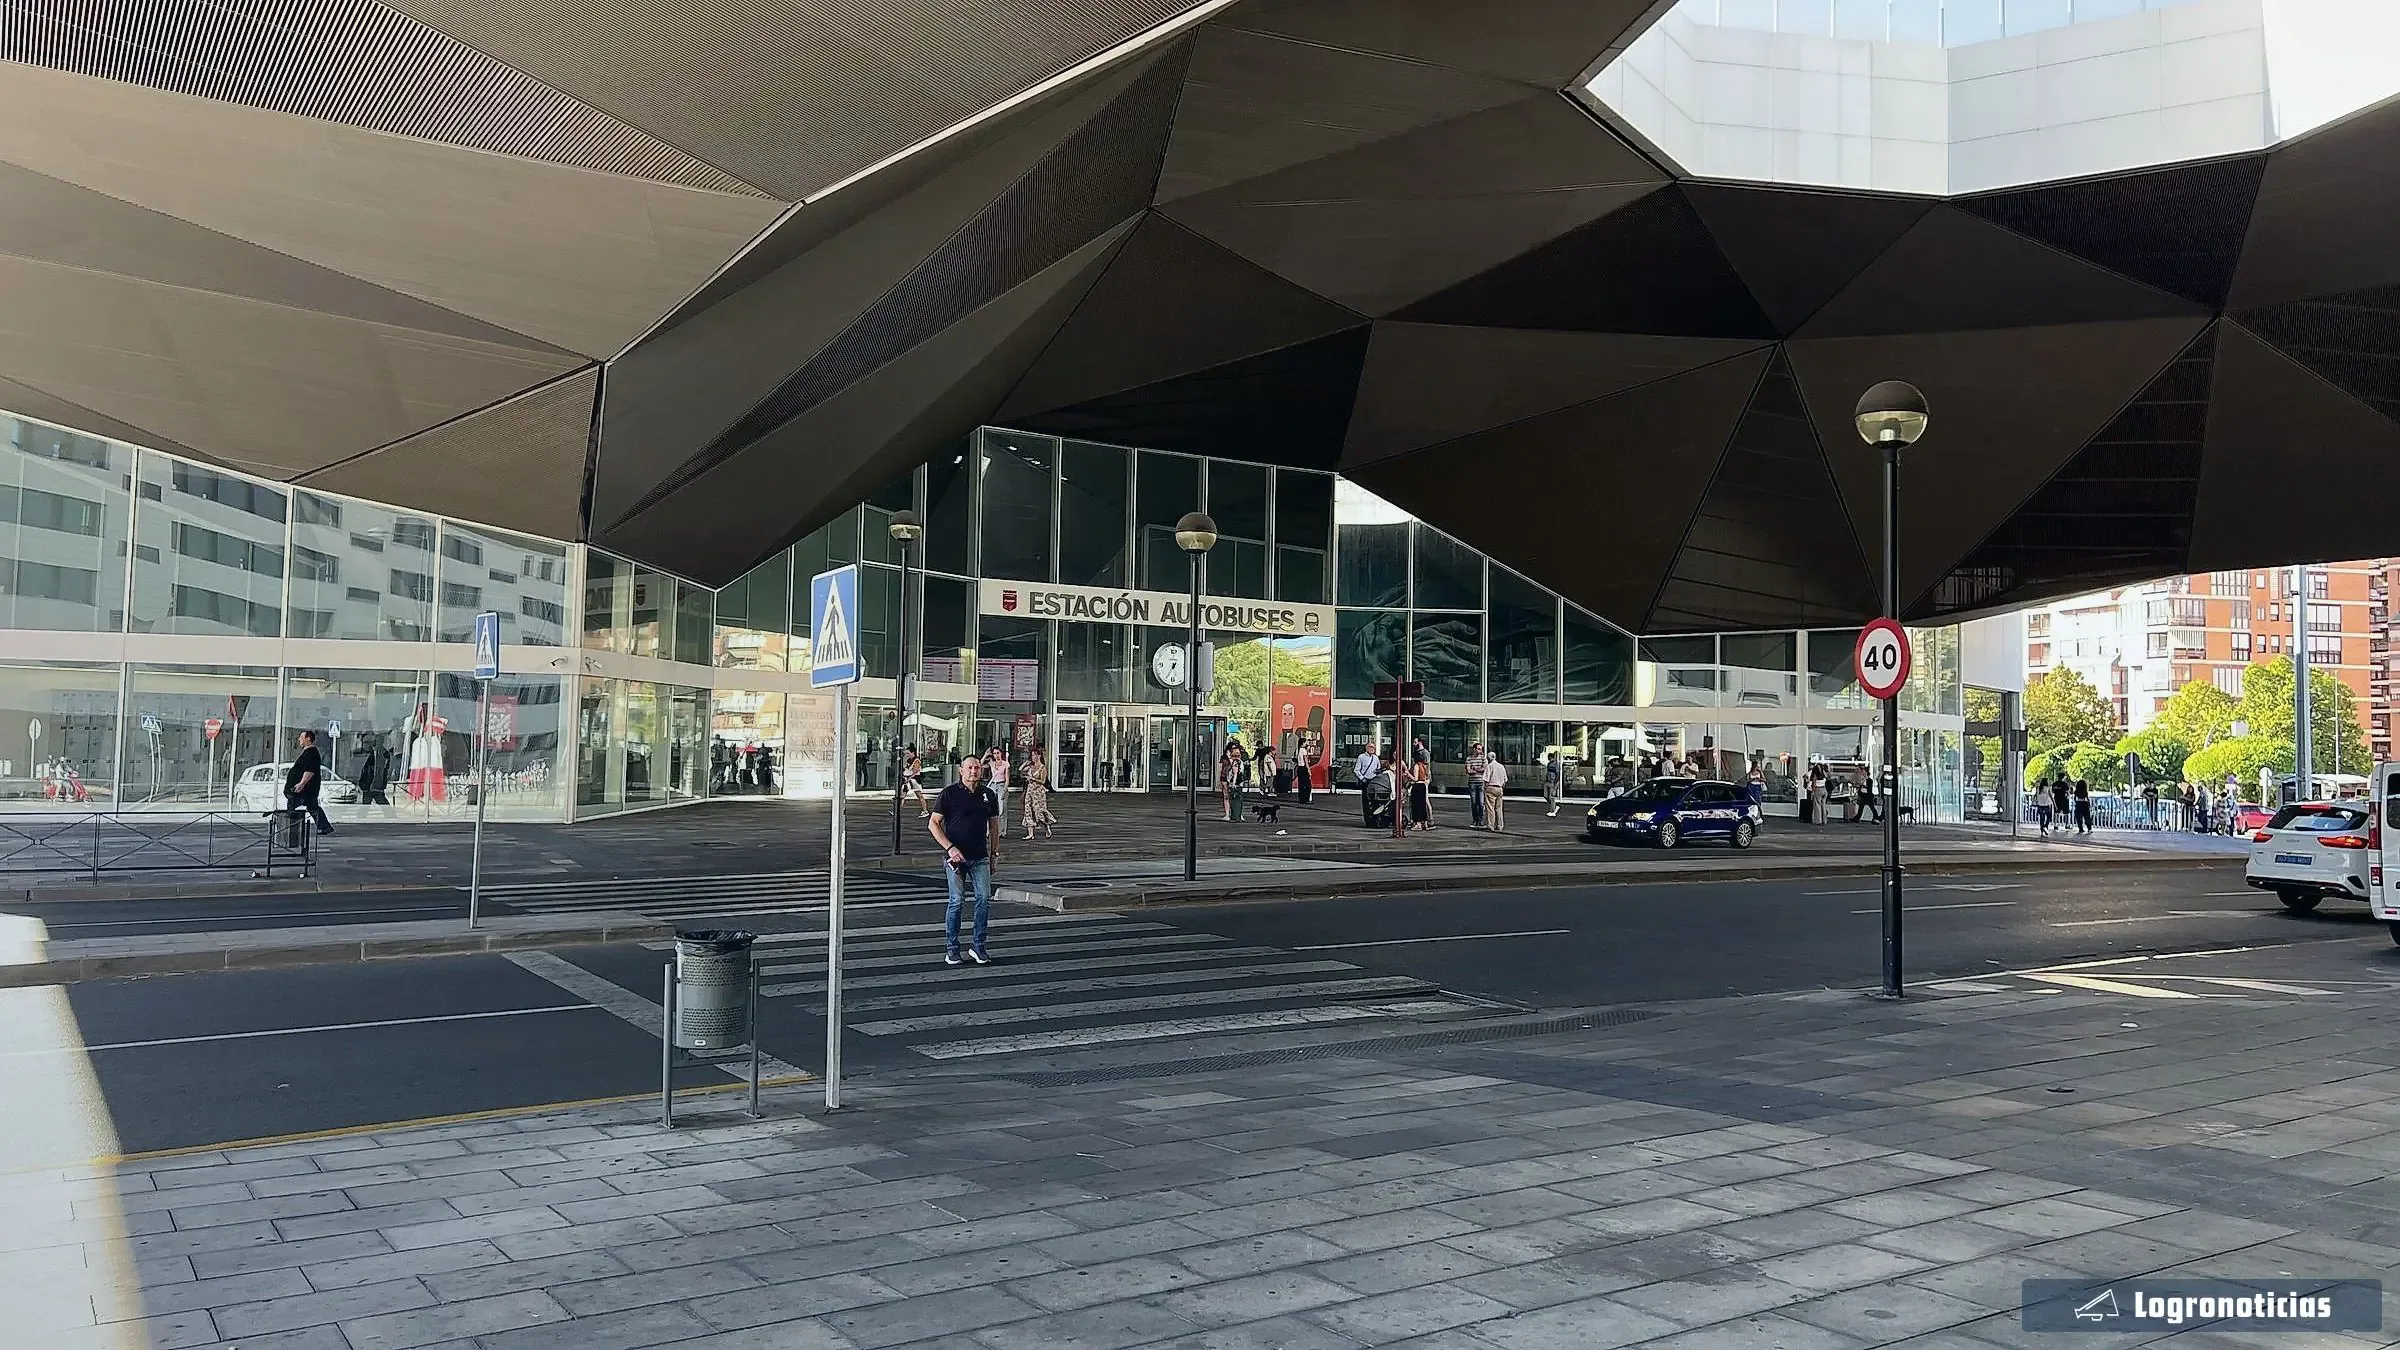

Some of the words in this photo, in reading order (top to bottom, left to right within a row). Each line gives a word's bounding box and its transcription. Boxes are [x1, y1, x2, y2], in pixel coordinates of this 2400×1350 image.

[1029, 591, 1149, 622] ESTACIÓN
[1161, 601, 1295, 631] AUTOBUSES
[1863, 643, 1897, 671] 40
